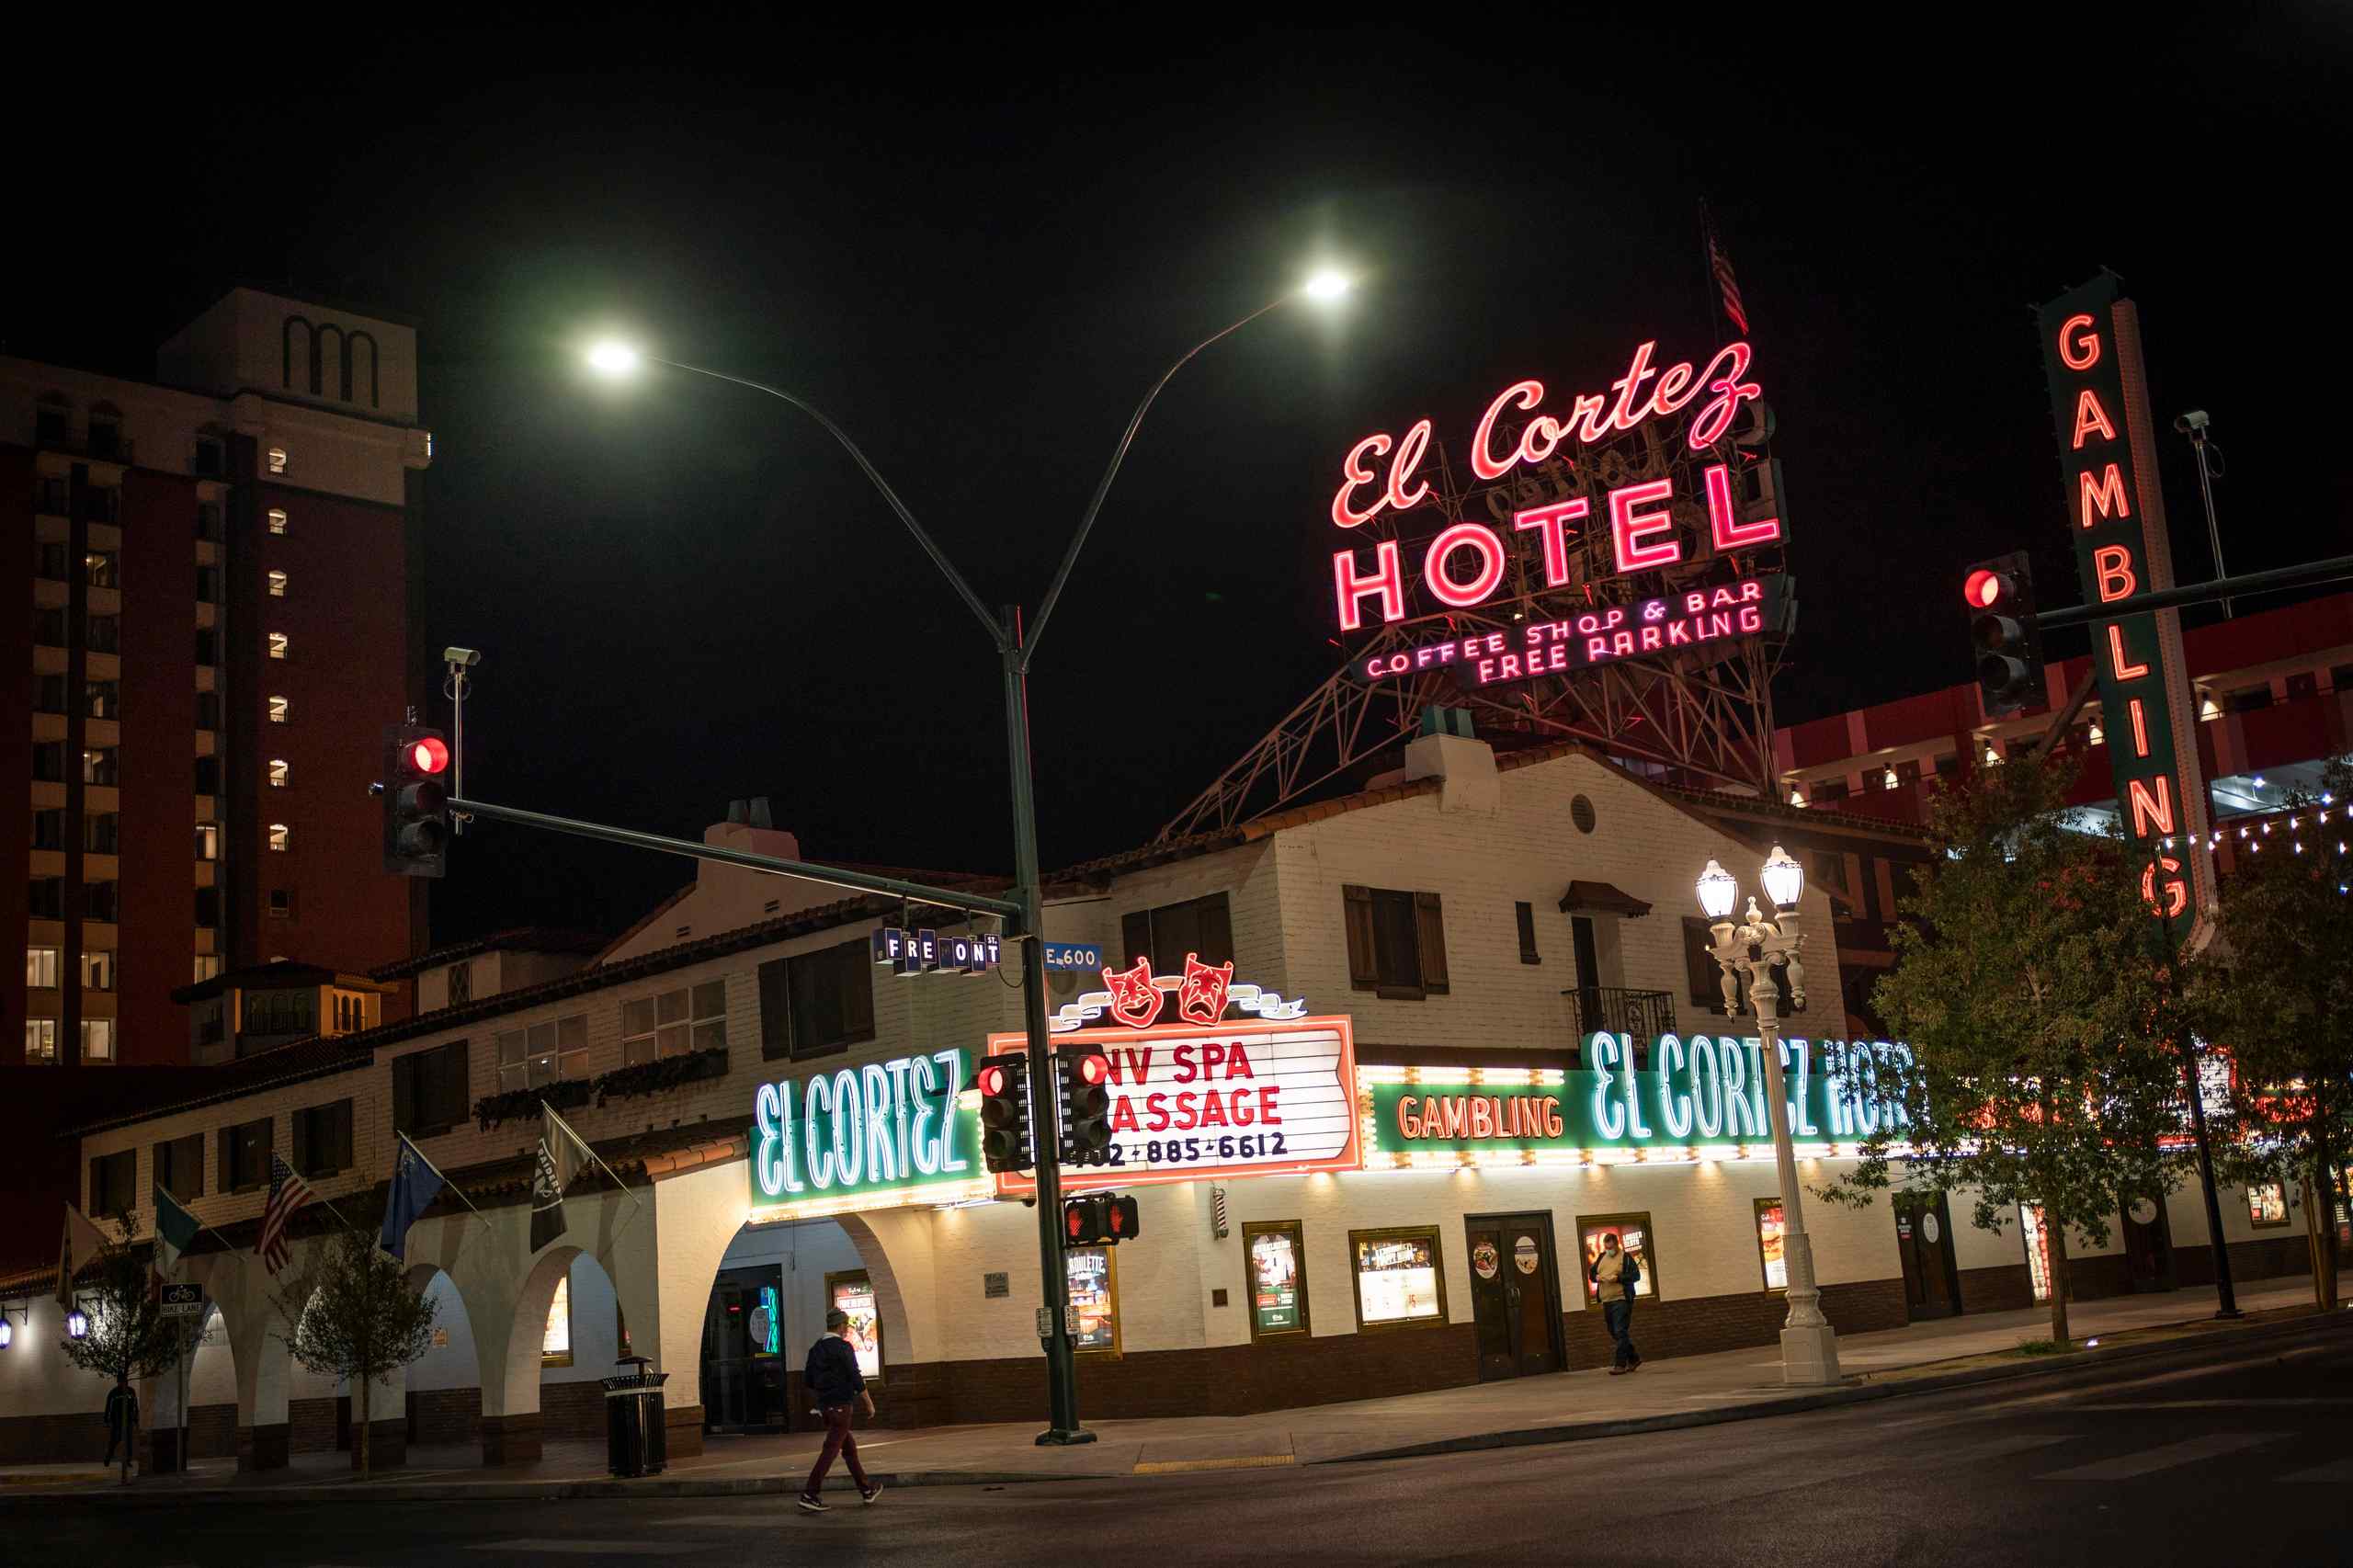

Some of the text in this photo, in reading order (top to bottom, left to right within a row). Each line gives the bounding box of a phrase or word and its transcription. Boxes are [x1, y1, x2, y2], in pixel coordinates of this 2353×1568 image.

[1332, 419, 1432, 528] El
[1471, 340, 1762, 480] Cortez
[1333, 463, 1780, 632] HOTEL
[1368, 581, 1763, 677] COFFEE SHOP & BAR
[1478, 605, 1762, 685] FREE PARKING
[2058, 313, 2188, 919] GAMBLING
[888, 938, 999, 963] FREONT
[1063, 949, 1096, 966] 600
[1173, 1041, 1255, 1085] SPA
[1591, 1030, 1653, 1140] EL
[756, 1048, 968, 1197] EL CORTEZ
[1111, 1085, 1282, 1133] ASSAGE
[1397, 1094, 1564, 1141] GAMBLING
[537, 1147, 562, 1195] RAIDERS
